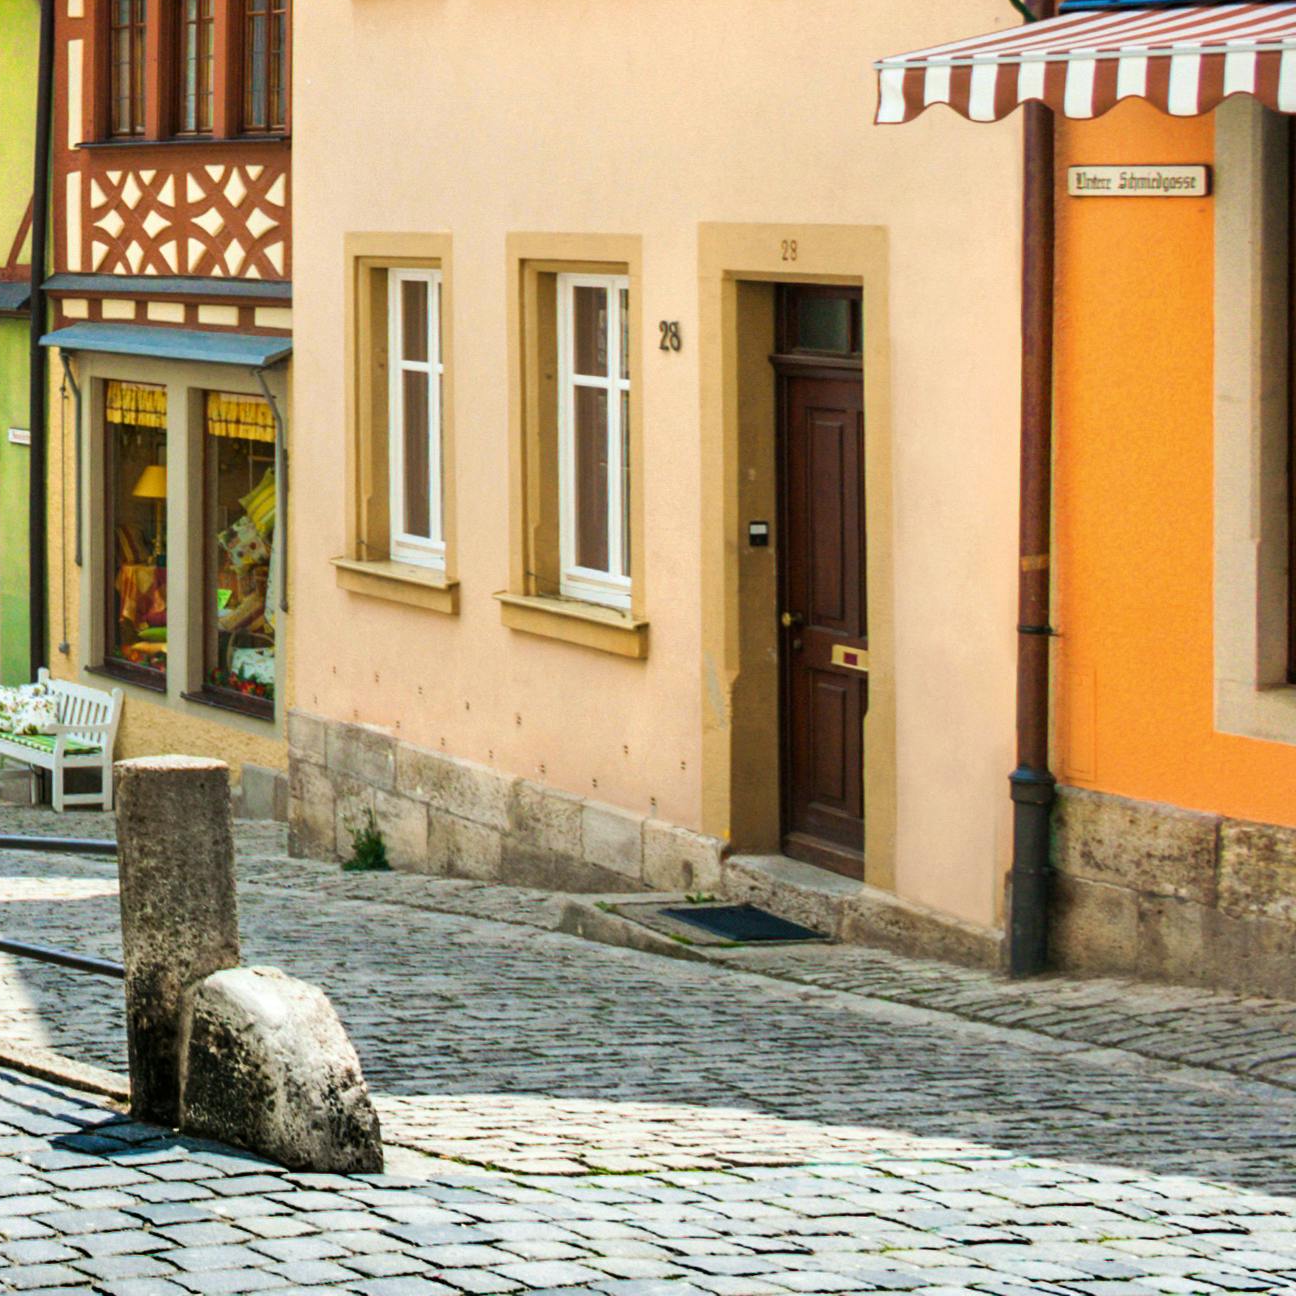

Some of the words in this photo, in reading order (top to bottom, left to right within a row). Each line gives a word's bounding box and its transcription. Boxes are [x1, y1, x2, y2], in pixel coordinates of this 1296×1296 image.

[1075, 171, 1112, 190] Untere
[780, 239, 798, 261] 28
[658, 320, 682, 352] 28
